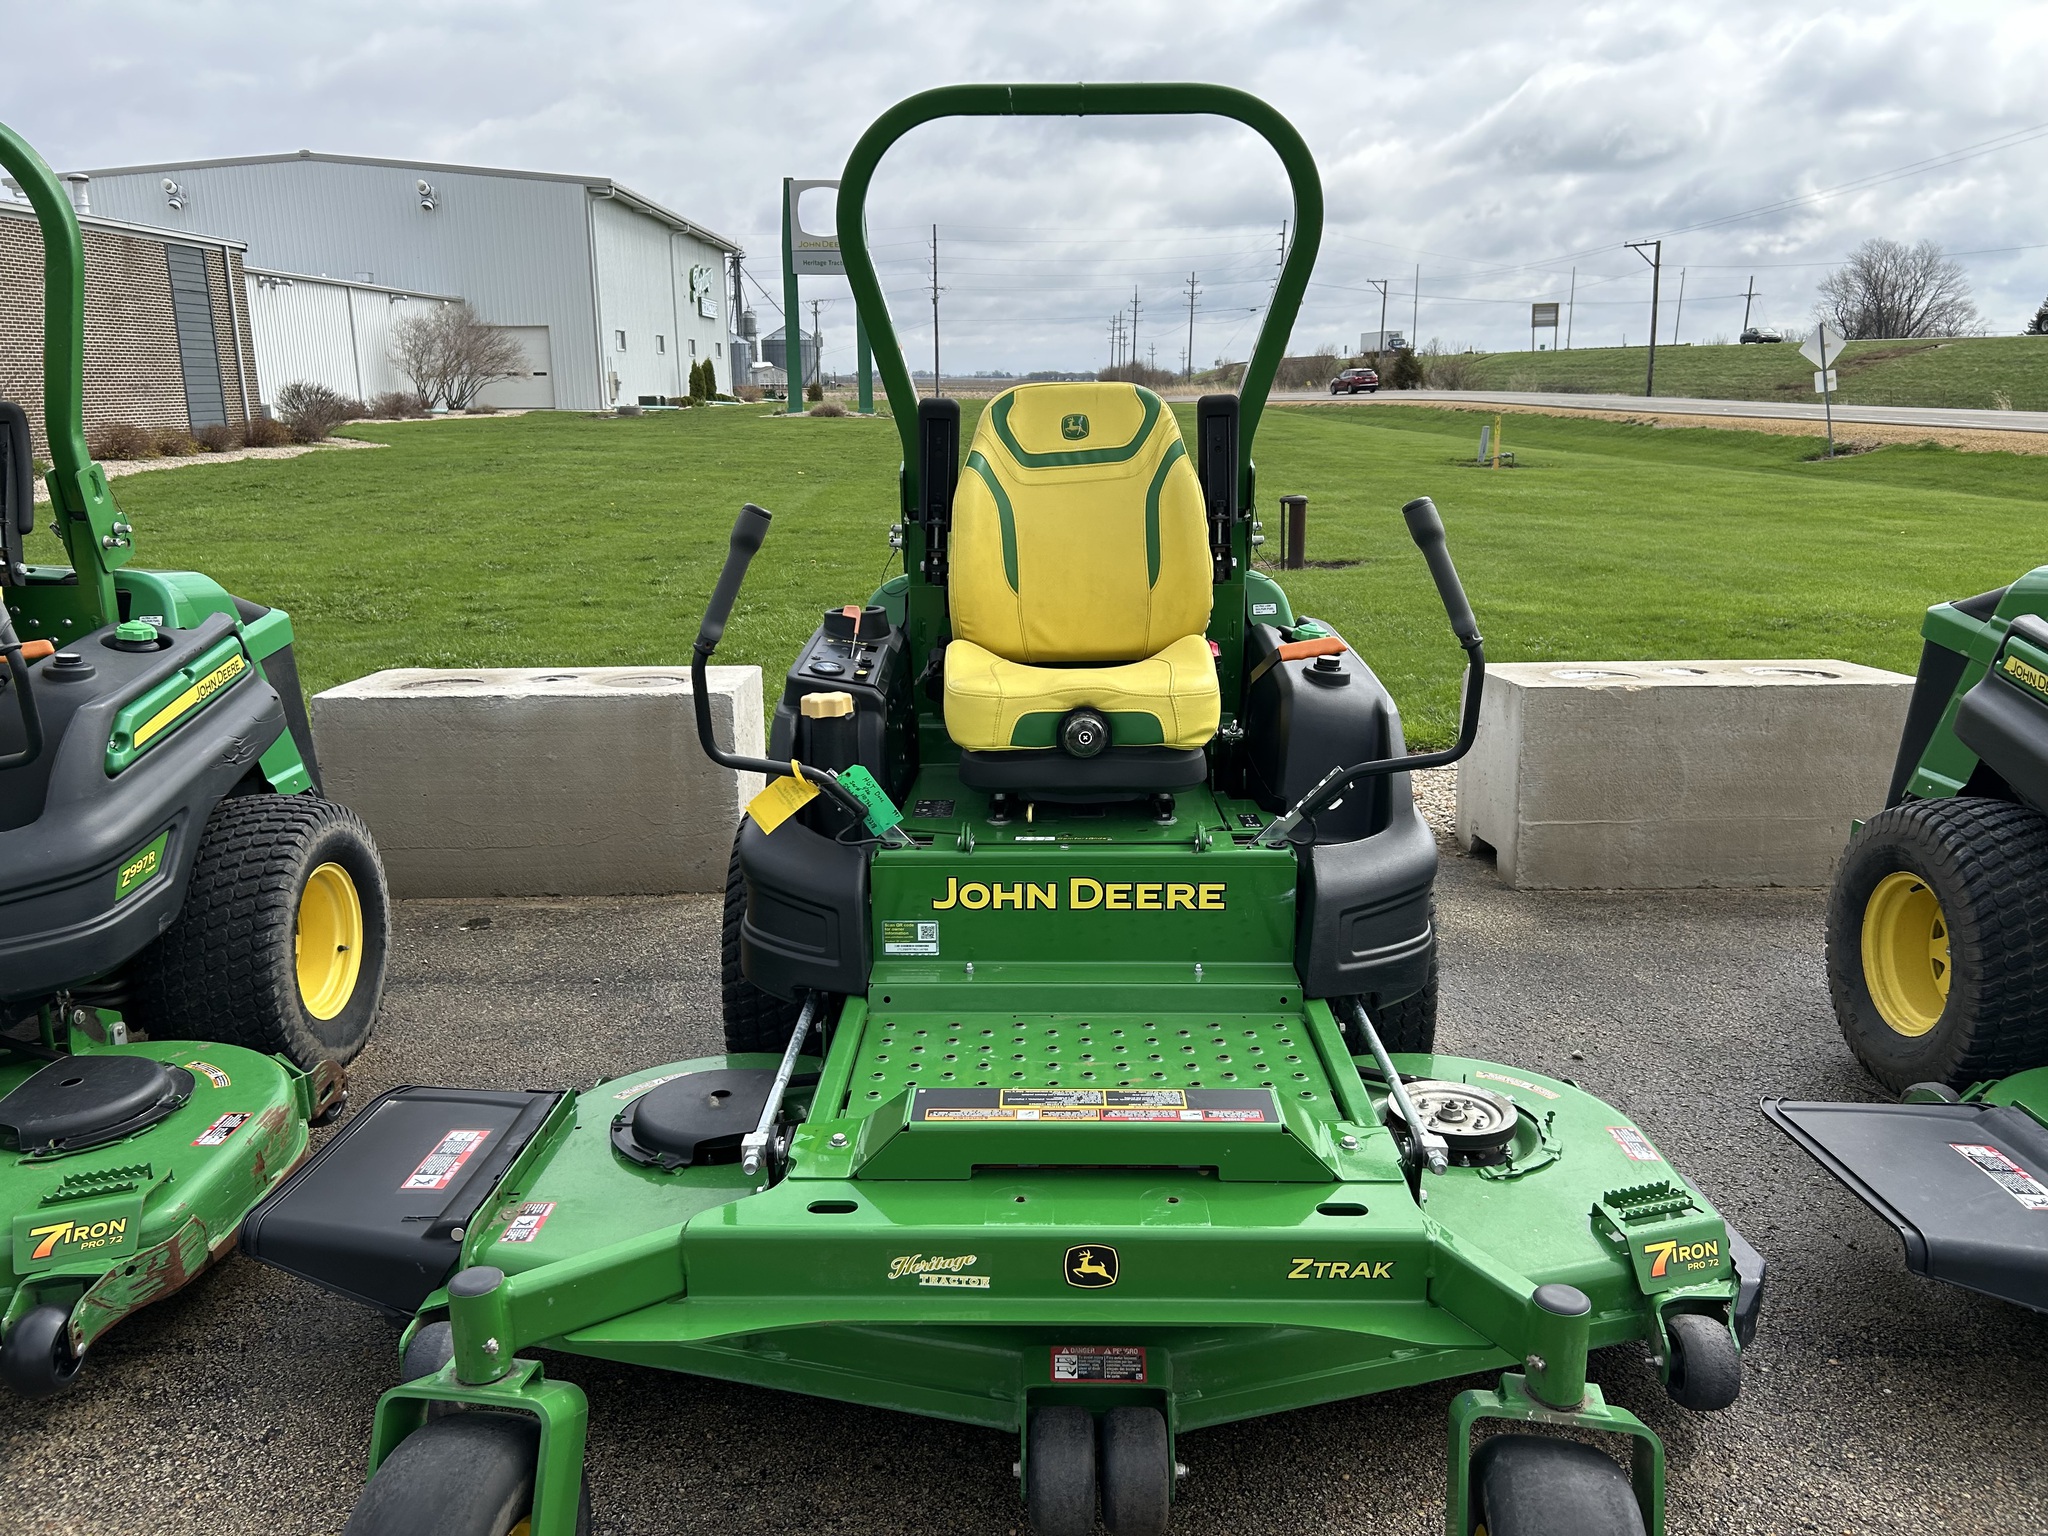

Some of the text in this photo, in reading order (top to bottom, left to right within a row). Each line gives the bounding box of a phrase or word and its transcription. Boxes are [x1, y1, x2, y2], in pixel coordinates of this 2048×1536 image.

[798, 240, 821, 248] JOHN
[802, 259, 827, 267] Heritage
[196, 659, 241, 701] JOHN DEERE
[2010, 661, 2037, 685] JOHN
[121, 850, 156, 888] Z997R
[932, 876, 1227, 910] JOHN DEERE
[80, 1236, 123, 1250] PRO 72
[888, 1253, 977, 1279] Heritage
[1287, 1257, 1397, 1279] ZTRAK
[1687, 1258, 1720, 1271] PRO 72
[919, 1274, 990, 1288] TRACTOR
[1112, 1347, 1139, 1355] PEGRO
